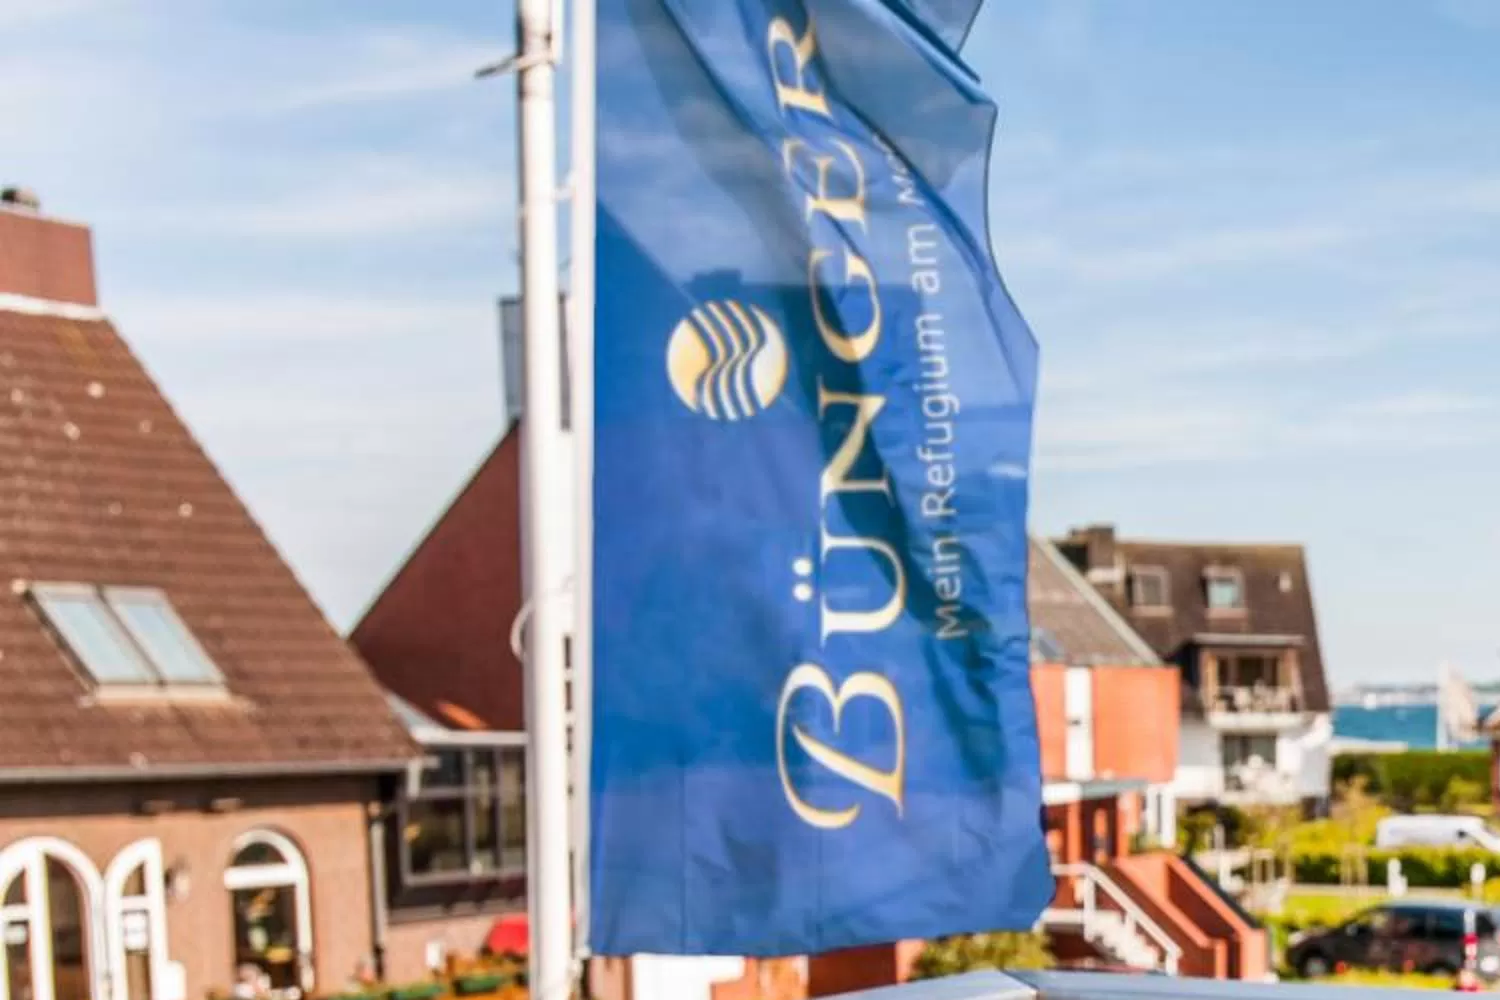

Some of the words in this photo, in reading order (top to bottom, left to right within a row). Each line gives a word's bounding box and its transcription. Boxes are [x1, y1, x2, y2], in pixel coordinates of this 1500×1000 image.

[906, 224, 942, 293] am
[768, 16, 905, 830] BÜNGER
[913, 314, 960, 518] Refugium
[934, 536, 969, 640] Mein
